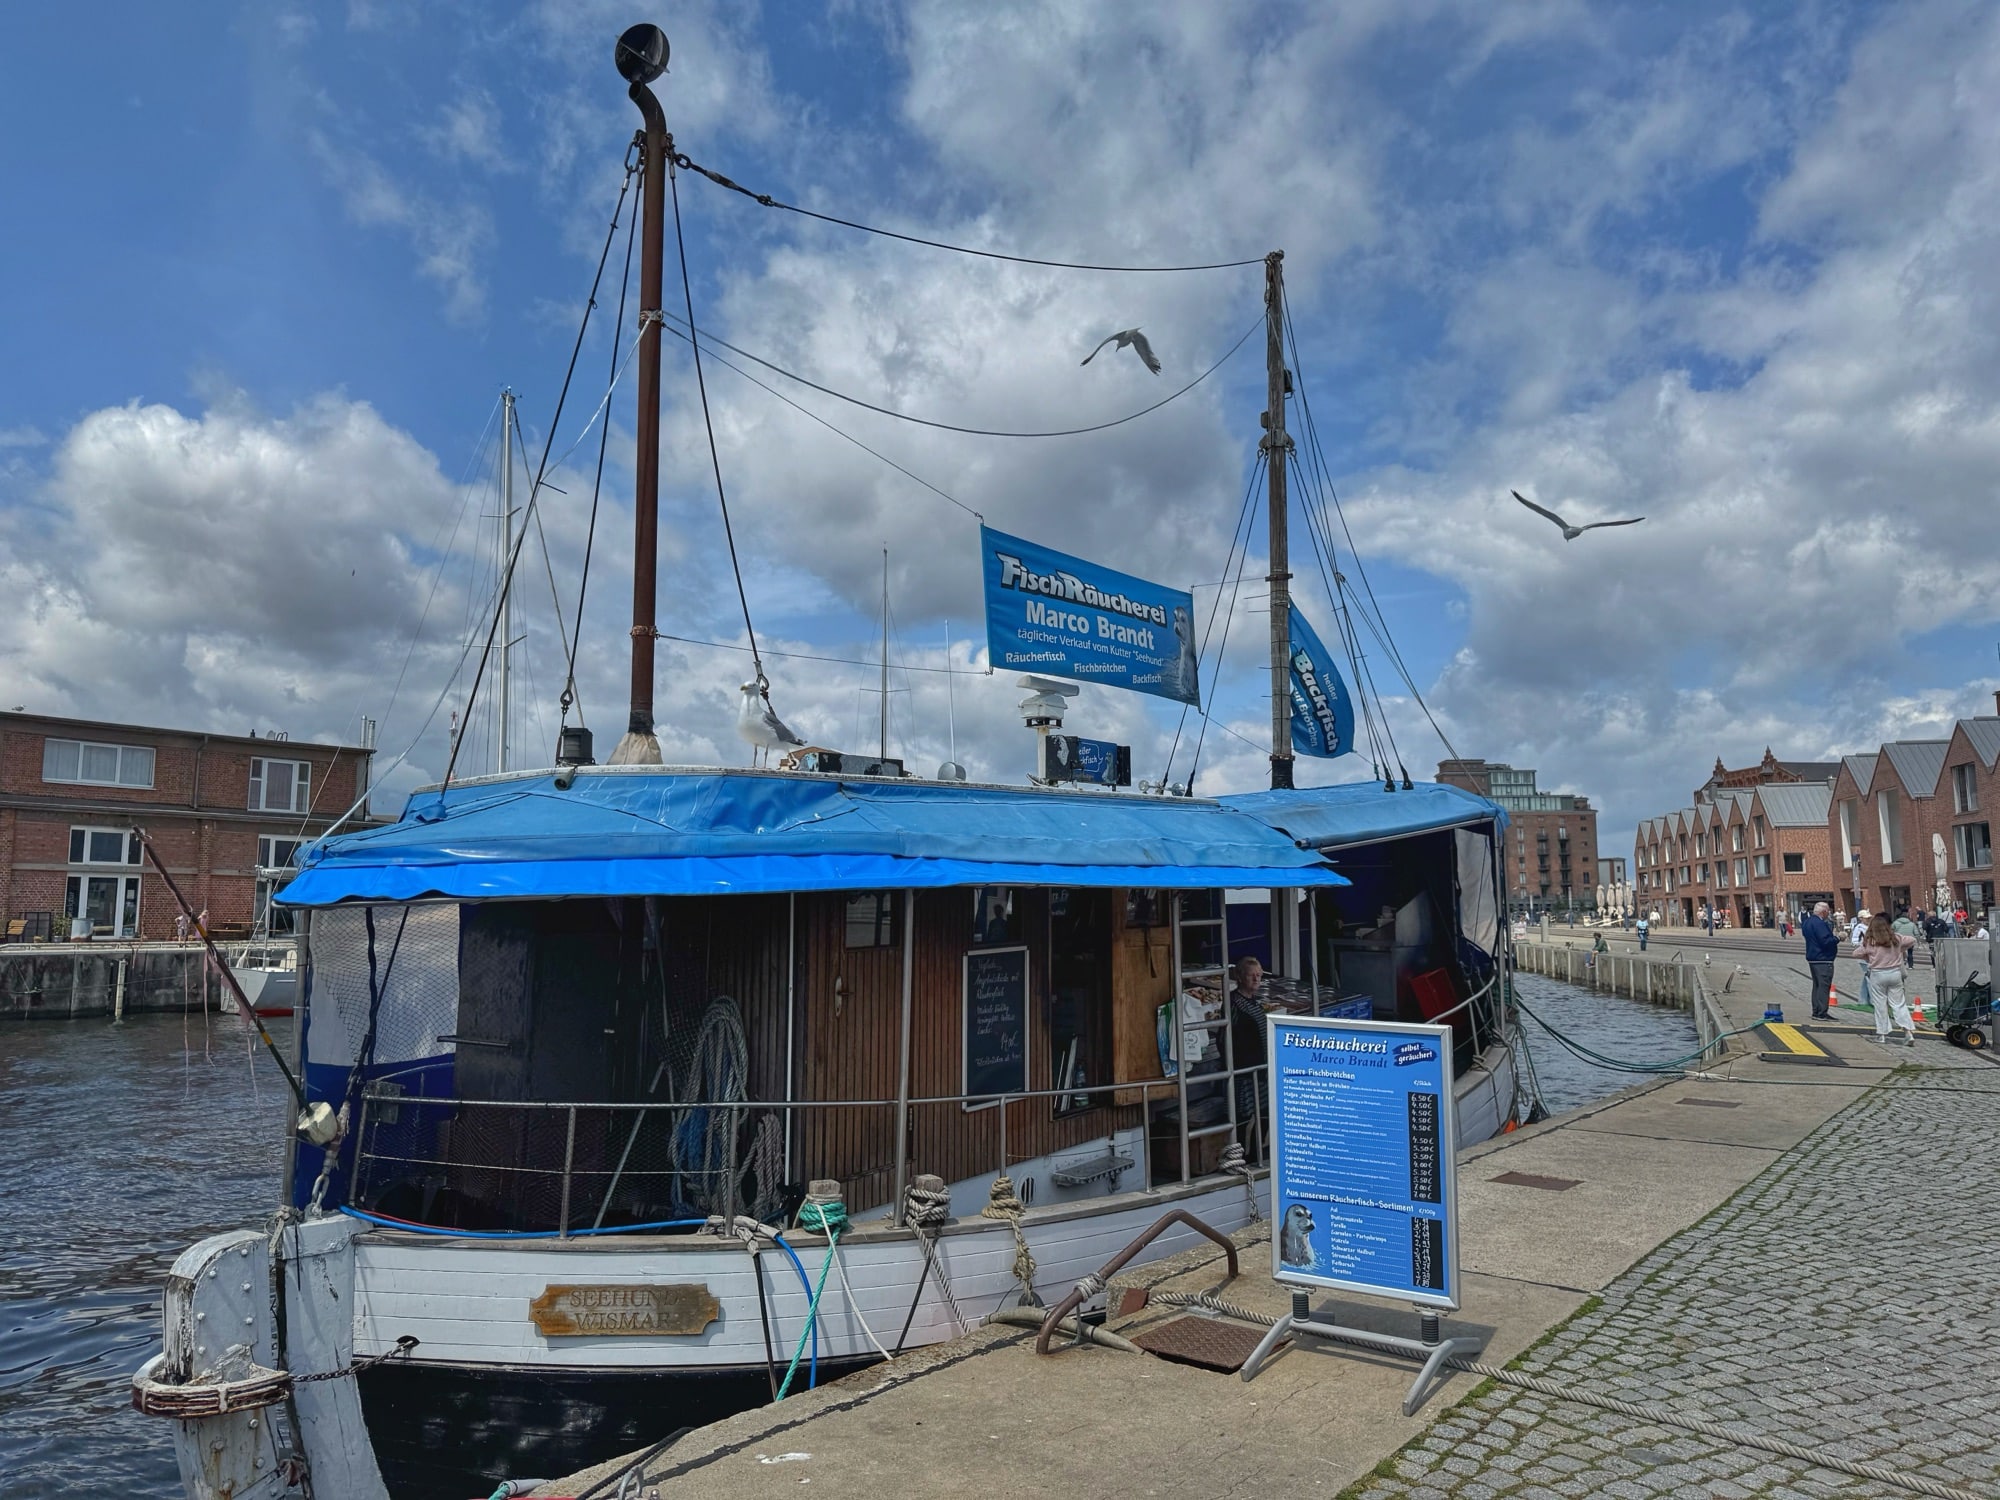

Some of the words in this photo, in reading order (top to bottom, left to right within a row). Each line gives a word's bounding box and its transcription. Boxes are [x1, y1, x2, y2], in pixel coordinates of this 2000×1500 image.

[996, 551, 1167, 628] FischRäucherei
[1026, 599, 1090, 634] Marco
[1097, 615, 1155, 650] Brandt
[1018, 628, 1057, 645] täglicher
[1059, 634, 1091, 650] Verkauf
[1092, 642, 1109, 654] vom
[1110, 643, 1131, 659] Kutter
[1005, 651, 1066, 663] Räucherfisch
[1074, 663, 1127, 674] Fischbrötchen
[1132, 674, 1162, 684] Backfisch
[1323, 673, 1338, 701] heißer
[1292, 648, 1339, 753] Backfisch
[1299, 703, 1318, 747] Brötchen
[1283, 1033, 1388, 1054] Fischräucherei
[1401, 1044, 1420, 1052] selbst
[1311, 1052, 1345, 1065] Marco
[1348, 1055, 1387, 1068] Brandt
[1399, 1051, 1433, 1064] geräuchert
[1283, 1066, 1306, 1075] Unsere
[1308, 1068, 1356, 1080] Fischbrötchen
[1286, 1188, 1298, 1197] Aus
[1300, 1191, 1329, 1201] unserem
[1330, 1194, 1414, 1212] Räucherfisch-Sortiment
[570, 1290, 680, 1308] SEEHUND
[575, 1312, 670, 1330] WISMAR
